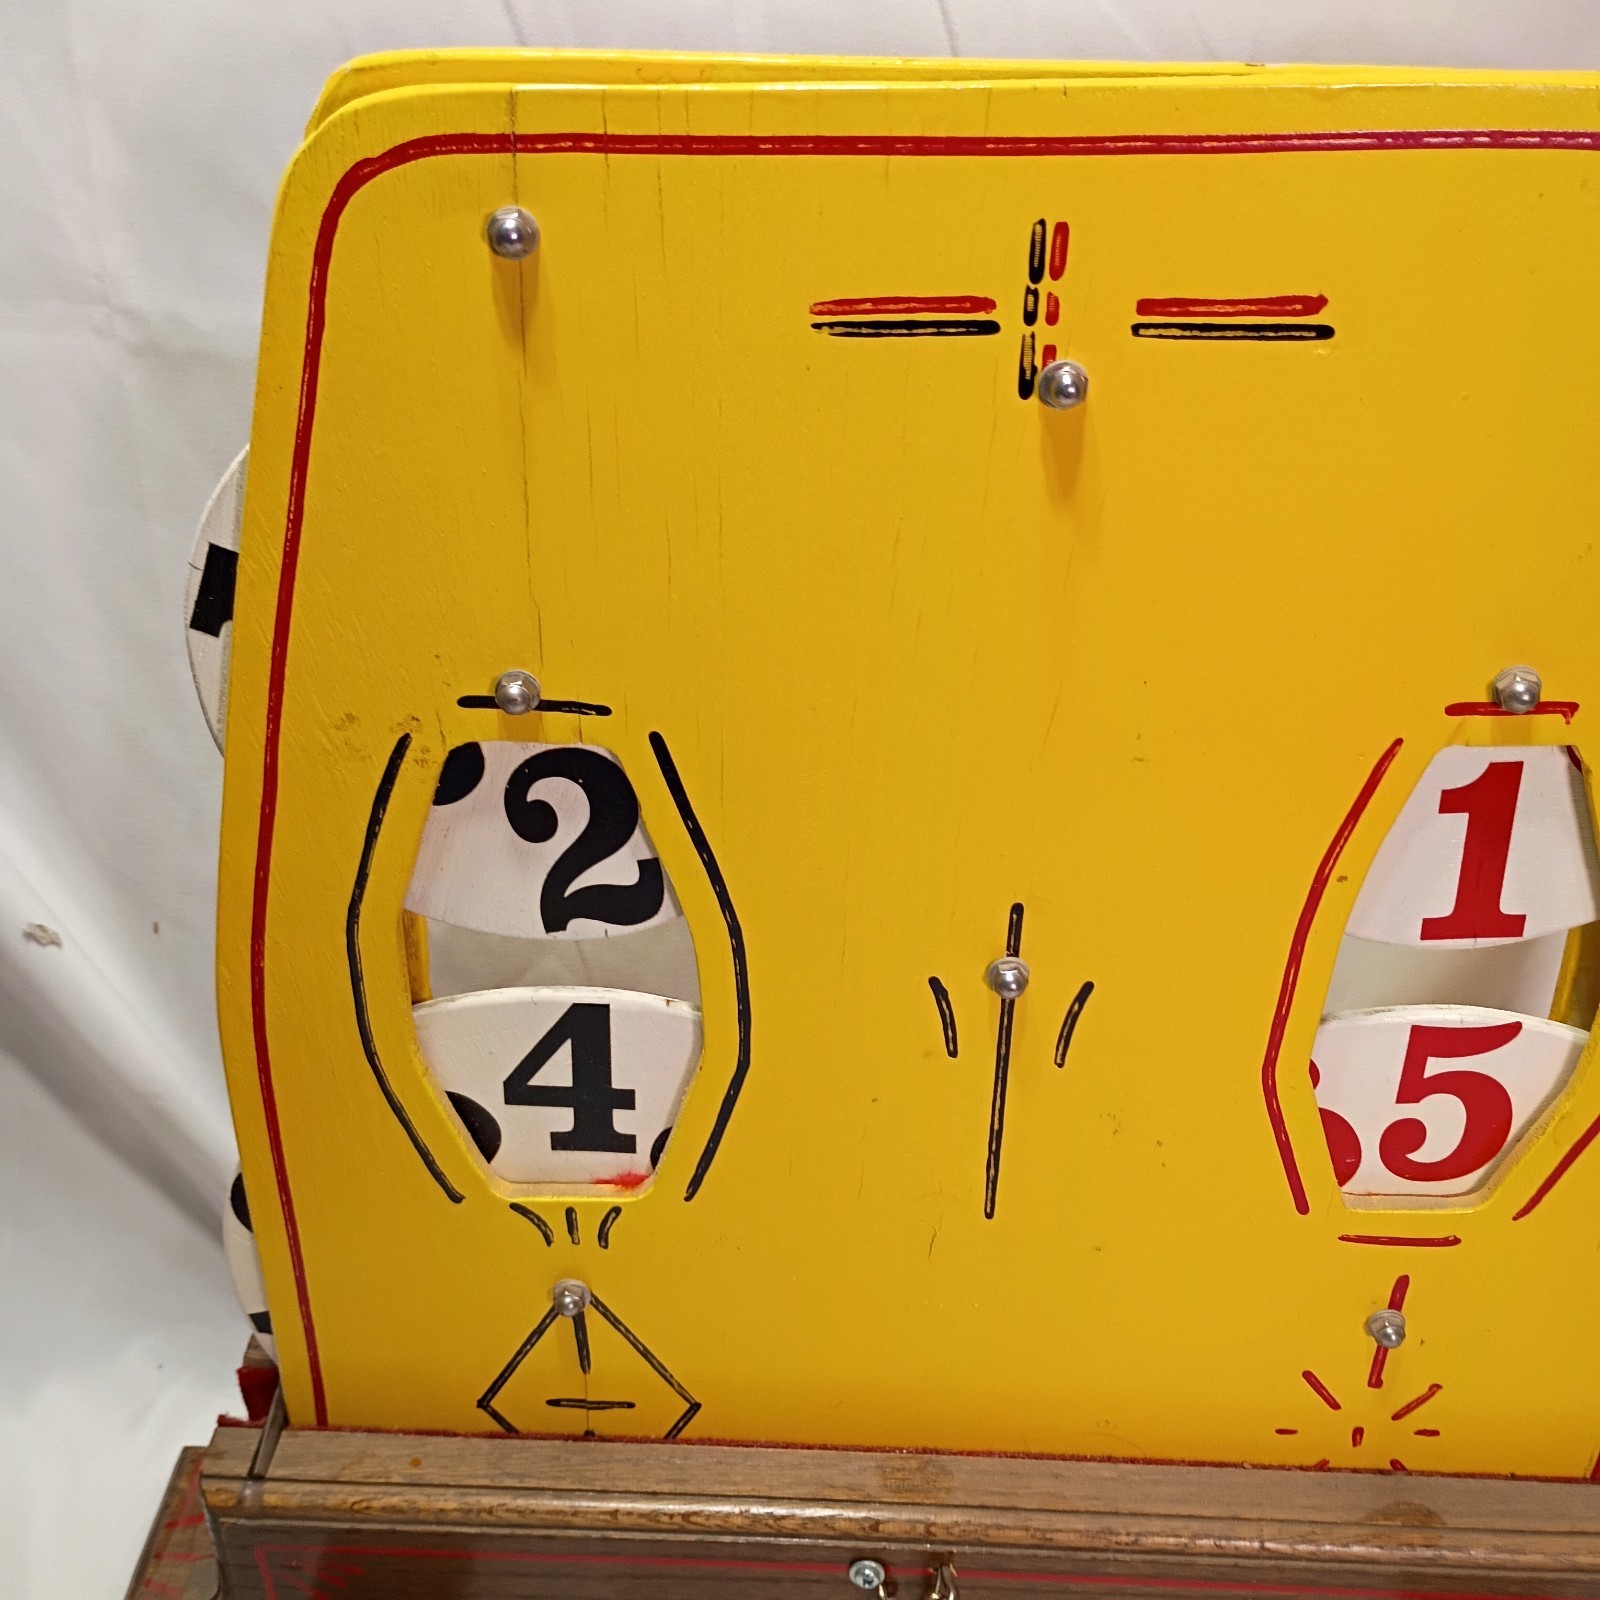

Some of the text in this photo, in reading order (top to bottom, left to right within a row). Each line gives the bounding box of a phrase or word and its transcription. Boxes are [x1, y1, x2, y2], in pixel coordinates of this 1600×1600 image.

[504, 747, 664, 934] 2
[1420, 761, 1526, 941] 1
[503, 1002, 637, 1154] 4
[1379, 1020, 1523, 1182] 5
